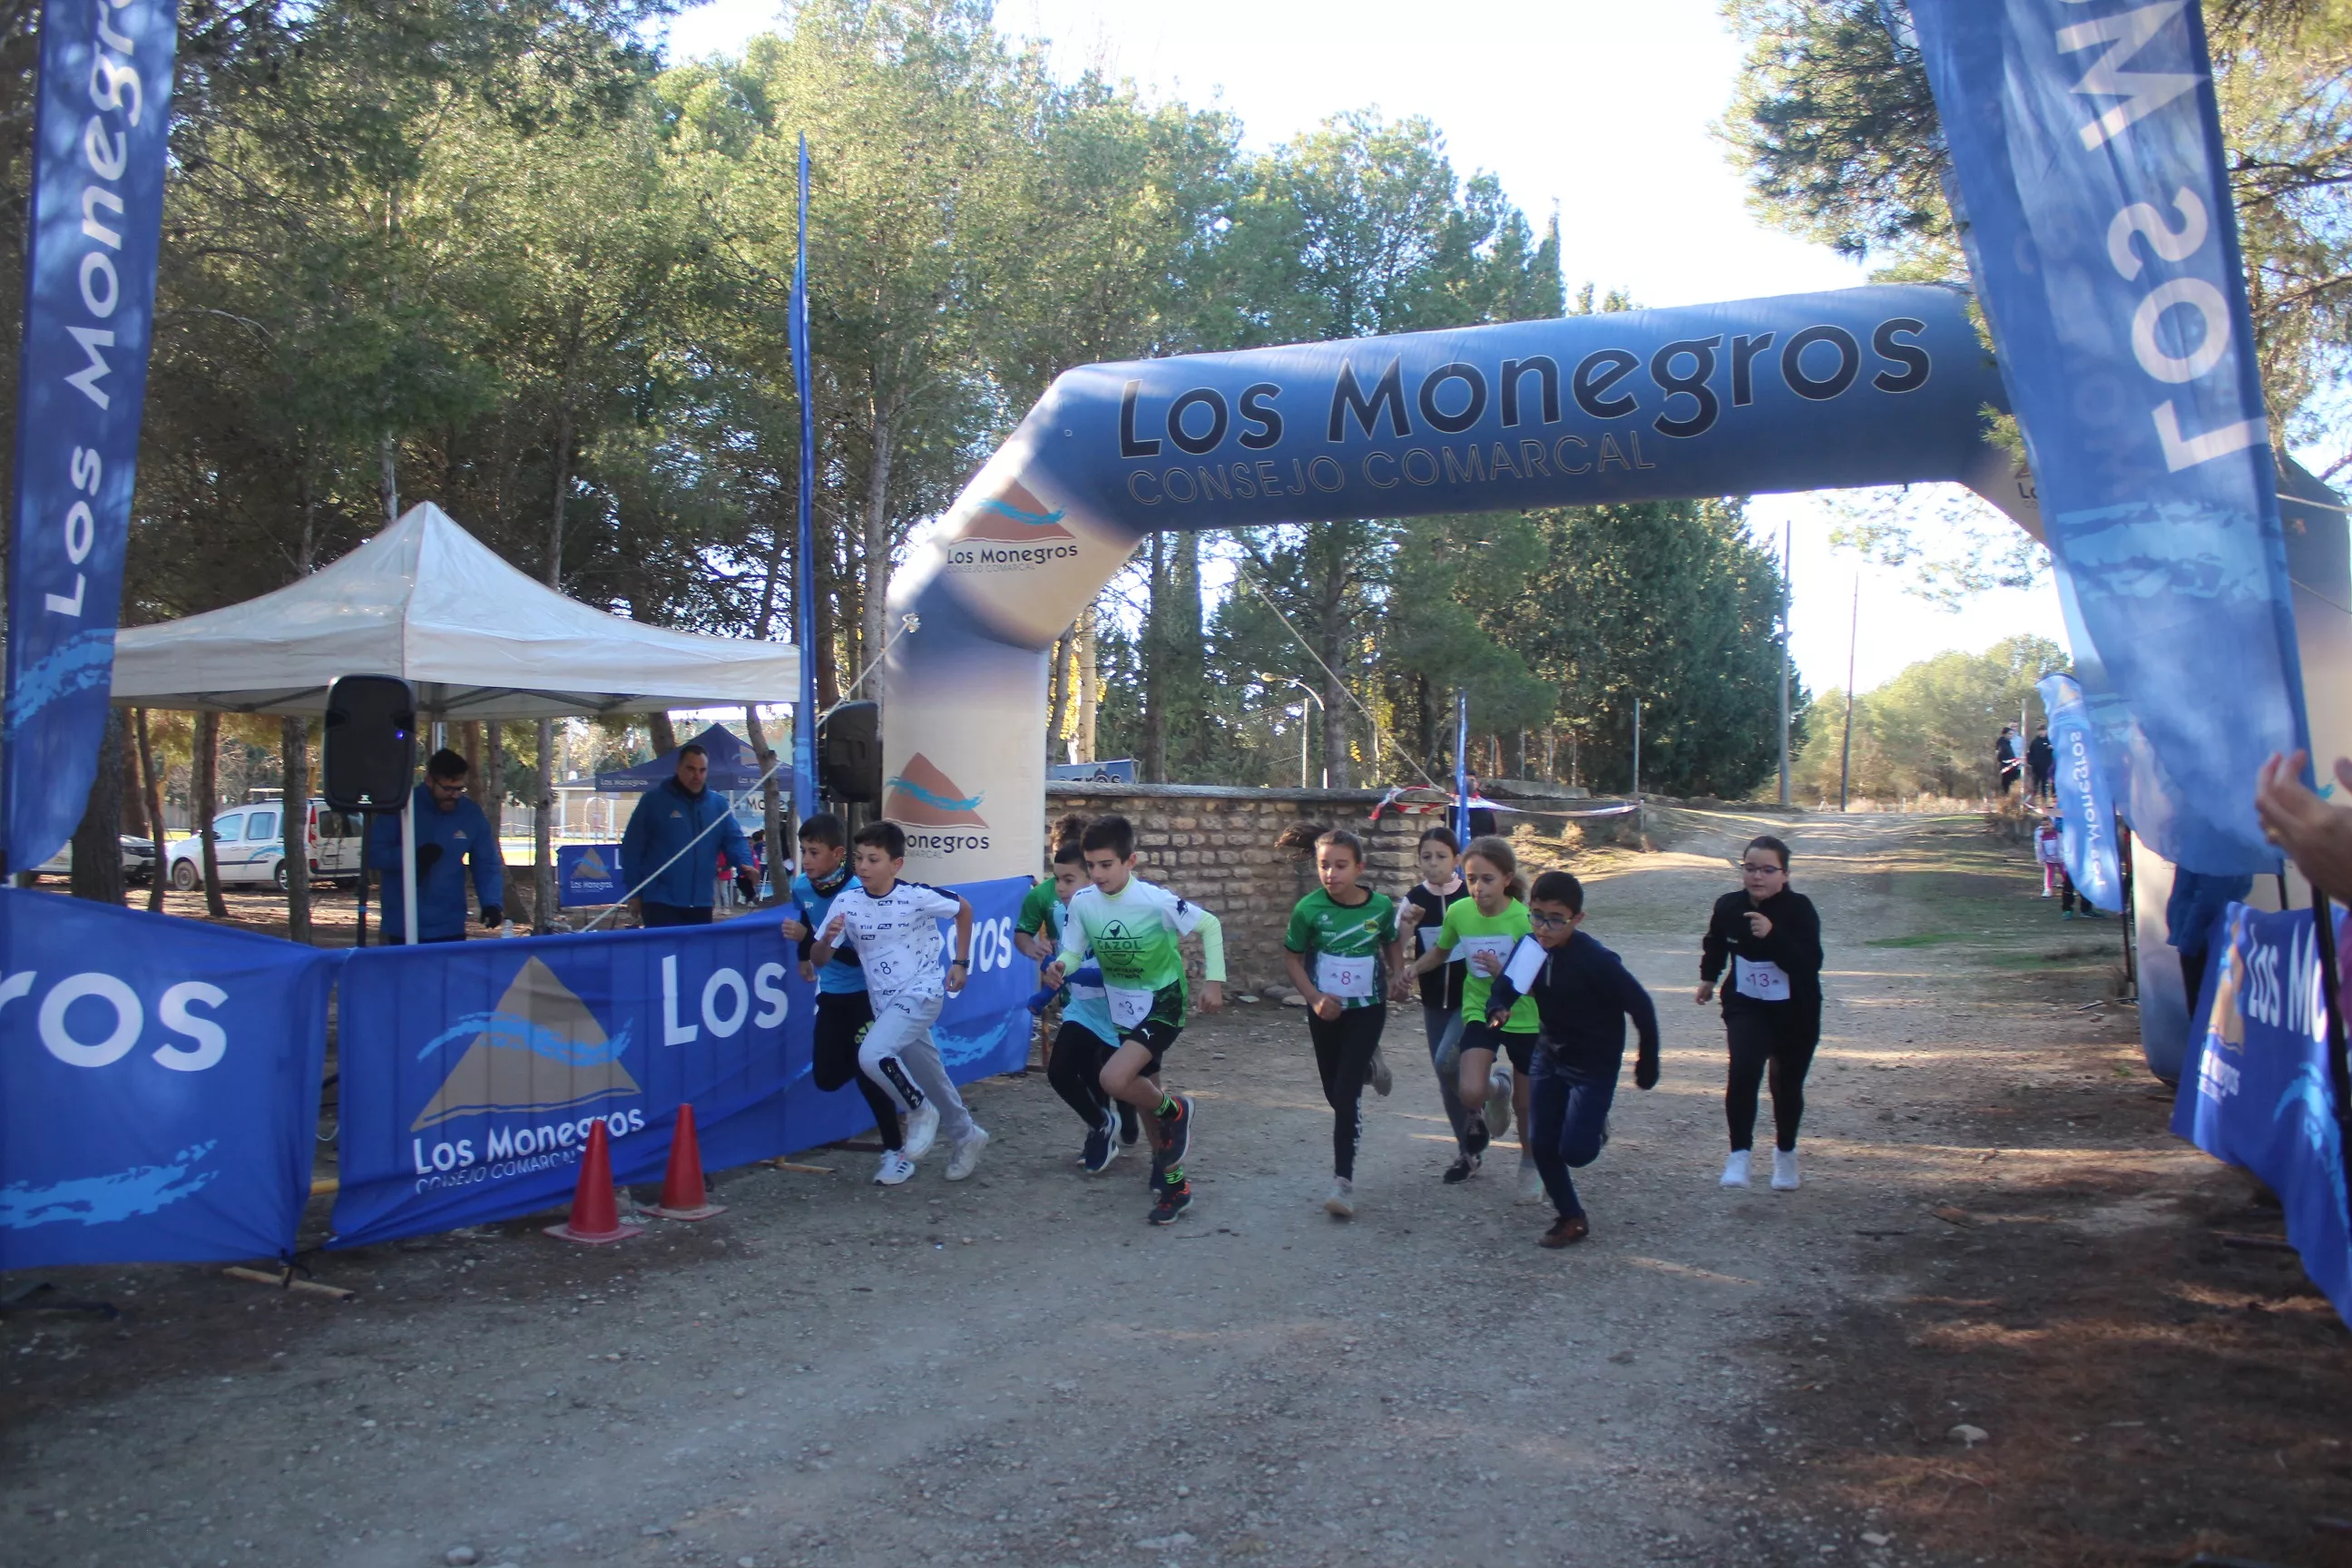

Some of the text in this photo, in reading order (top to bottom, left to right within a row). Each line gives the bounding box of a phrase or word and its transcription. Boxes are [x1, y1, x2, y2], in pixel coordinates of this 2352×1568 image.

[45, 0, 142, 618] Los Monegr
[1119, 317, 1931, 458] Los Monegros
[1127, 430, 1655, 505] CONSEJO COMARCAL
[947, 545, 1078, 564] Los Monegros
[906, 835, 989, 853] onegros
[1097, 940, 1142, 950] GAZOL
[879, 961, 892, 975] 8
[1341, 971, 1350, 985] 8
[1749, 973, 1769, 987] 13
[662, 955, 789, 1046] Los
[1124, 1001, 1134, 1015] 3
[413, 1138, 475, 1174] Los
